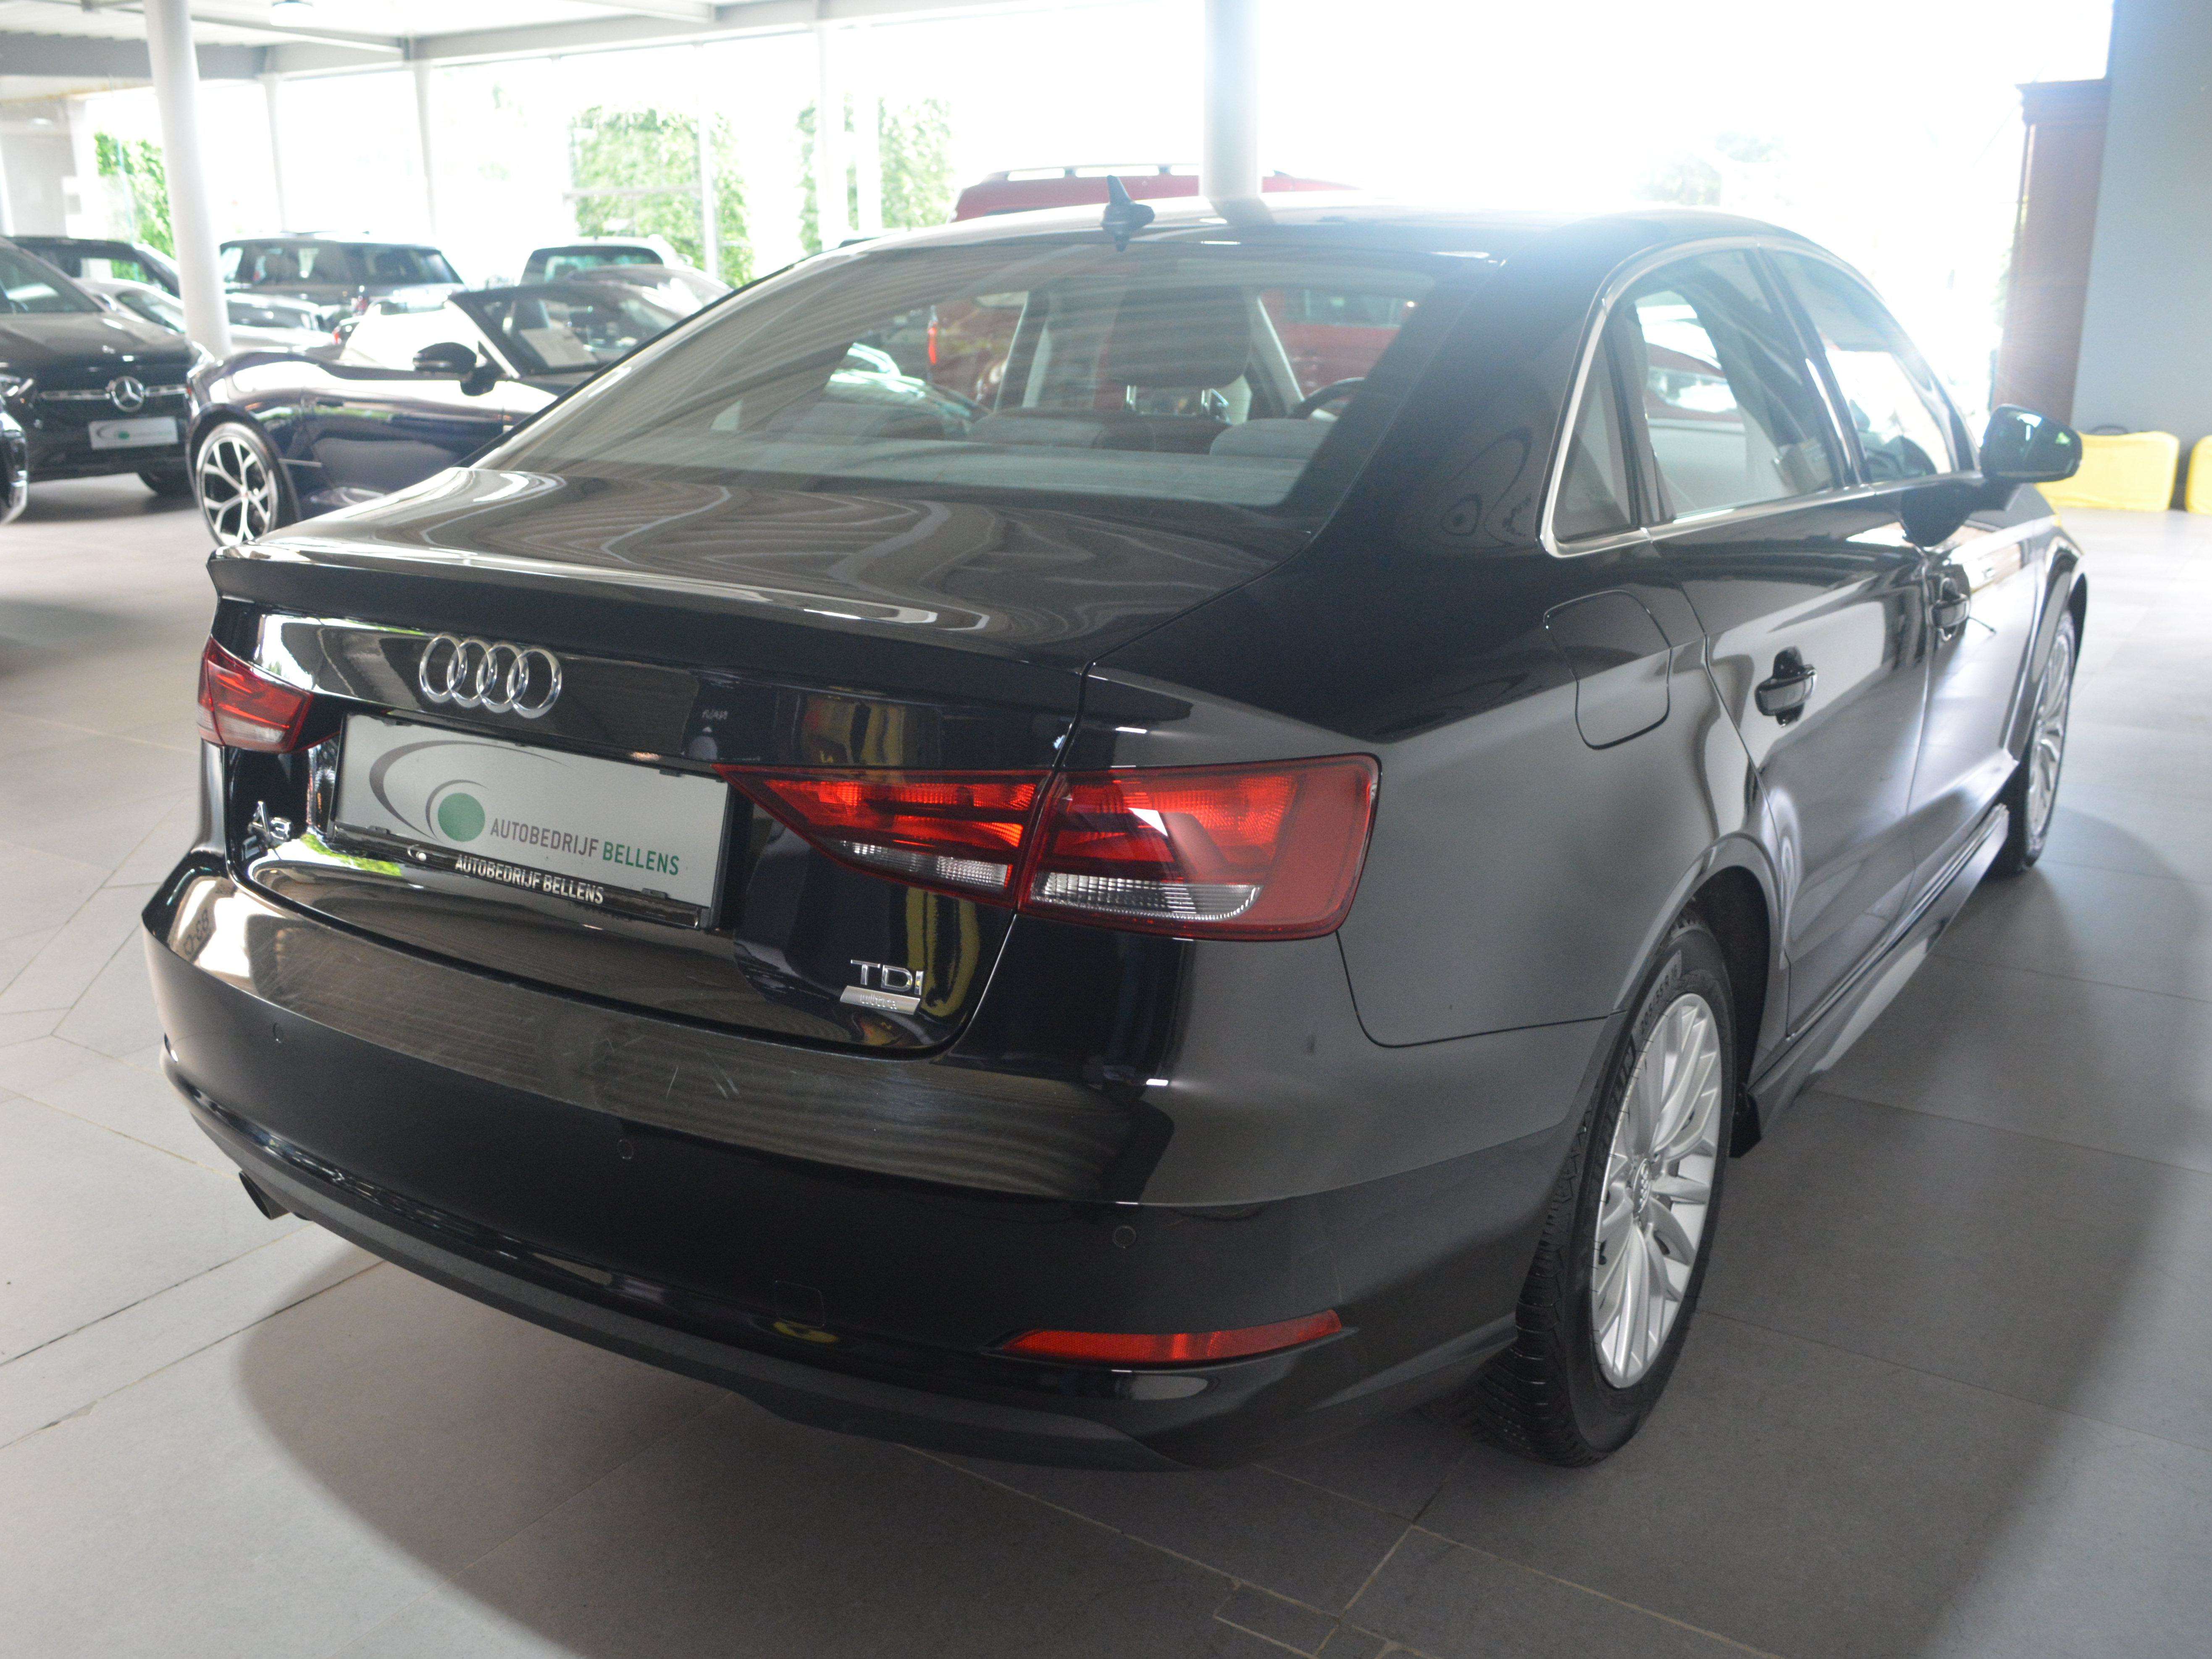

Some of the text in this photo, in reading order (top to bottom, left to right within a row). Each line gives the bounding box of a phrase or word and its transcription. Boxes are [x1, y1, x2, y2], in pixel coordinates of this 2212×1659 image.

[247, 800, 291, 842] A3
[490, 817, 680, 876] AUTOBEDRIJF BELLENS
[454, 854, 604, 904] AUTOBEDRIJF BELLENS
[850, 959, 924, 996] TDI
